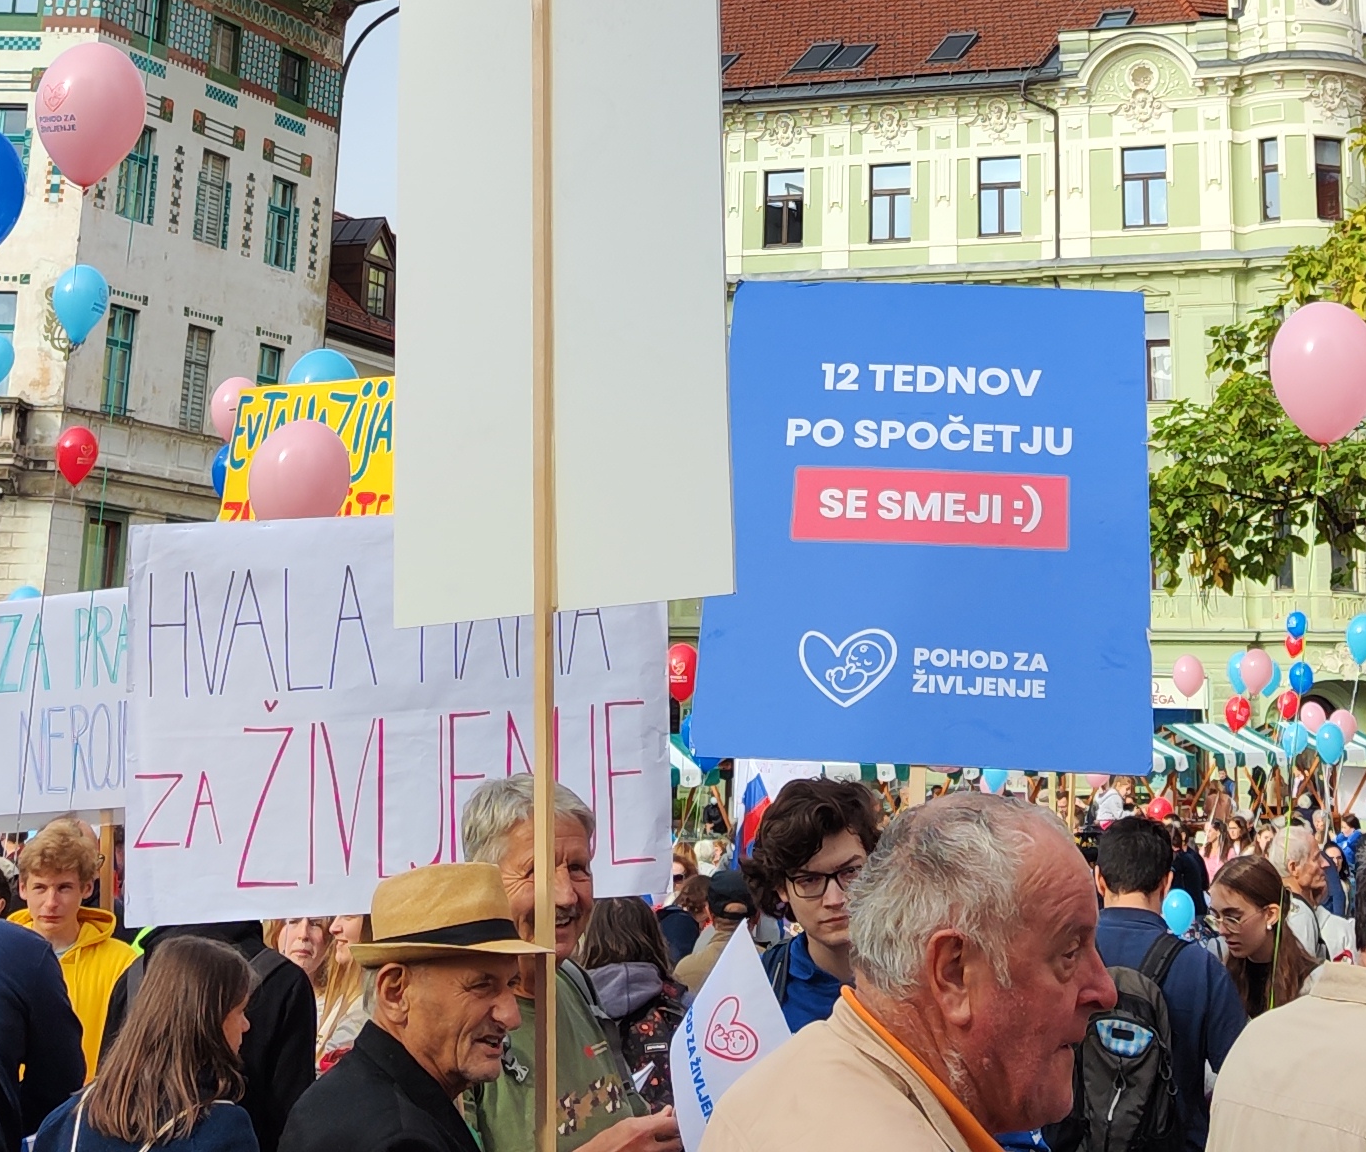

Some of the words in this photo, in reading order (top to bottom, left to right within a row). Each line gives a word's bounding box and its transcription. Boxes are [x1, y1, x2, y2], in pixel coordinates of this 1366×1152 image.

[821, 363, 860, 391] 12
[868, 364, 1043, 397] TEDNOV
[786, 418, 845, 447] PO
[854, 414, 1073, 456] SPOČETJU
[819, 488, 869, 520] SE
[877, 489, 1002, 525] SMEJI
[149, 565, 378, 698] HVALA
[913, 647, 1009, 671] POHOD
[1013, 651, 1049, 673] ZA
[912, 668, 1046, 699] ŽIVLJENJE
[1151, 694, 1176, 705] EGA
[18, 699, 128, 795] NEROJ
[134, 770, 223, 850] ZA
